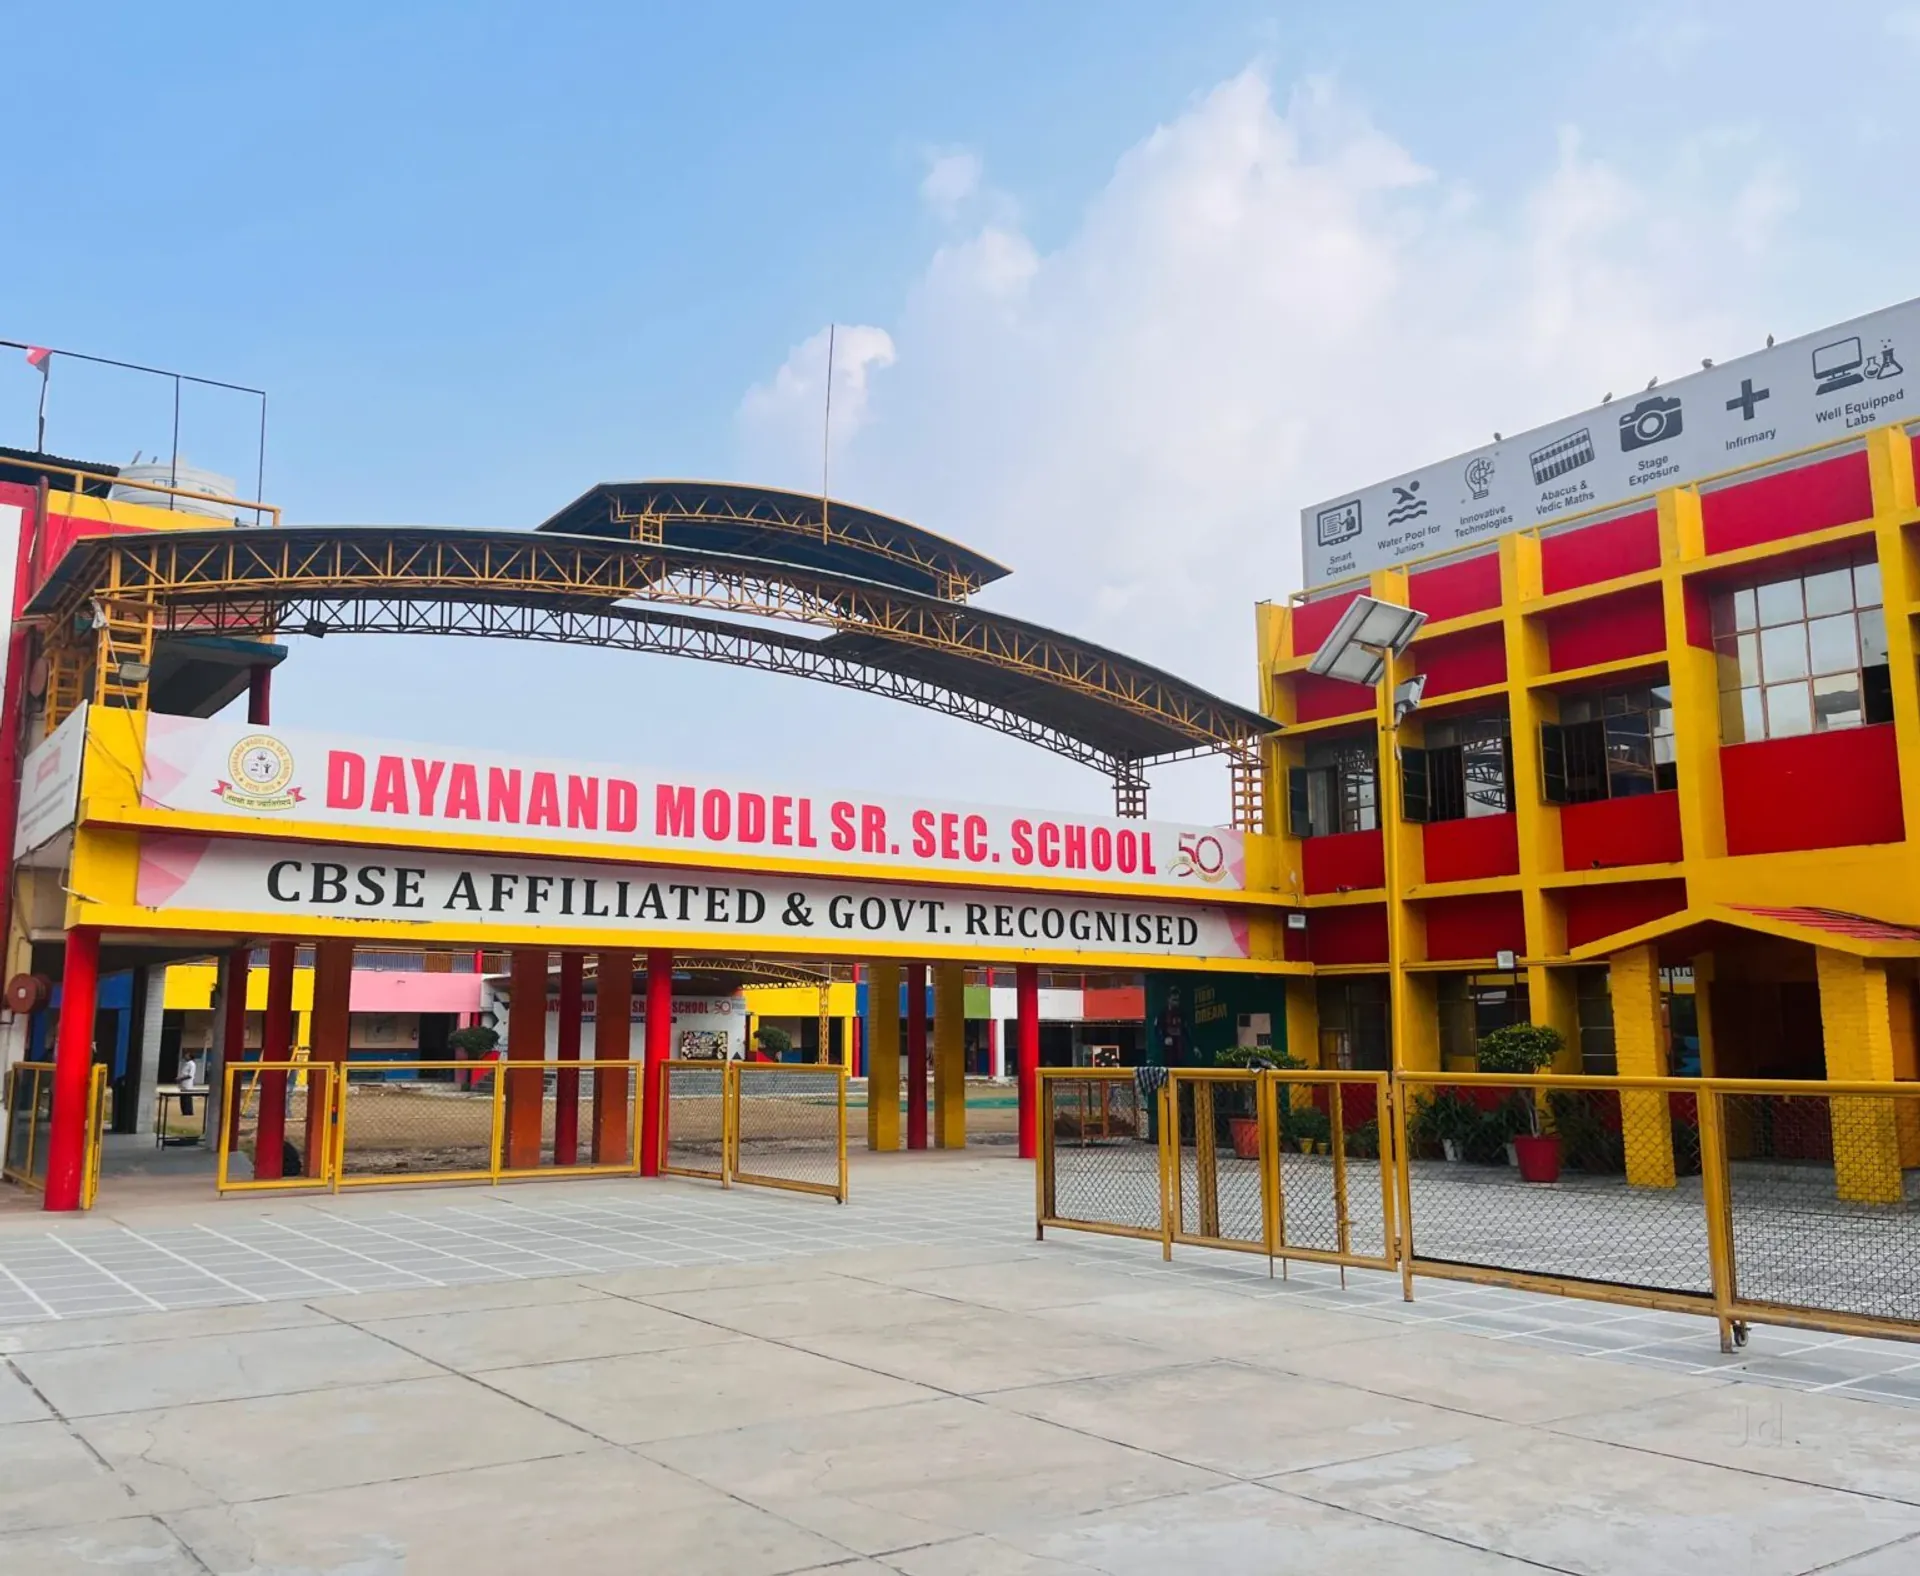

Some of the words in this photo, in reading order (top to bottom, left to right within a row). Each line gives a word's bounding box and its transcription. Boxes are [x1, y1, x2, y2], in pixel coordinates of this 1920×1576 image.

[1815, 406, 1842, 423] Well
[1845, 388, 1904, 415] Equipped
[1846, 412, 1876, 428] Labs
[1725, 428, 1777, 450] Infirmary
[1638, 454, 1669, 471] Stage
[1628, 463, 1680, 486] Exposure
[1541, 484, 1578, 501] Abacus
[1579, 480, 1588, 490] &
[1535, 500, 1562, 516] Vedic
[1565, 491, 1595, 506] Maths
[1460, 505, 1506, 525] Innovative
[1377, 535, 1403, 550] Water
[1404, 528, 1426, 542] Pool
[1427, 524, 1442, 535] for
[1454, 514, 1514, 539] Technologies
[1330, 550, 1352, 565] Smart
[1393, 540, 1425, 556] Juniors
[1326, 561, 1356, 576] Classes
[327, 751, 638, 833] DAYANAND
[655, 784, 818, 848] MODEL
[831, 801, 900, 855] SR.
[912, 809, 1000, 863] SEC.
[1011, 818, 1157, 875] SCHOOL
[1178, 832, 1223, 877] 50
[267, 859, 426, 908] CBSE
[443, 870, 766, 924] AFFILIATED
[781, 891, 814, 927] &
[828, 894, 951, 934] GOVT.
[964, 902, 1199, 946] RECOGNISED
[672, 1000, 709, 1014] SCHOOL
